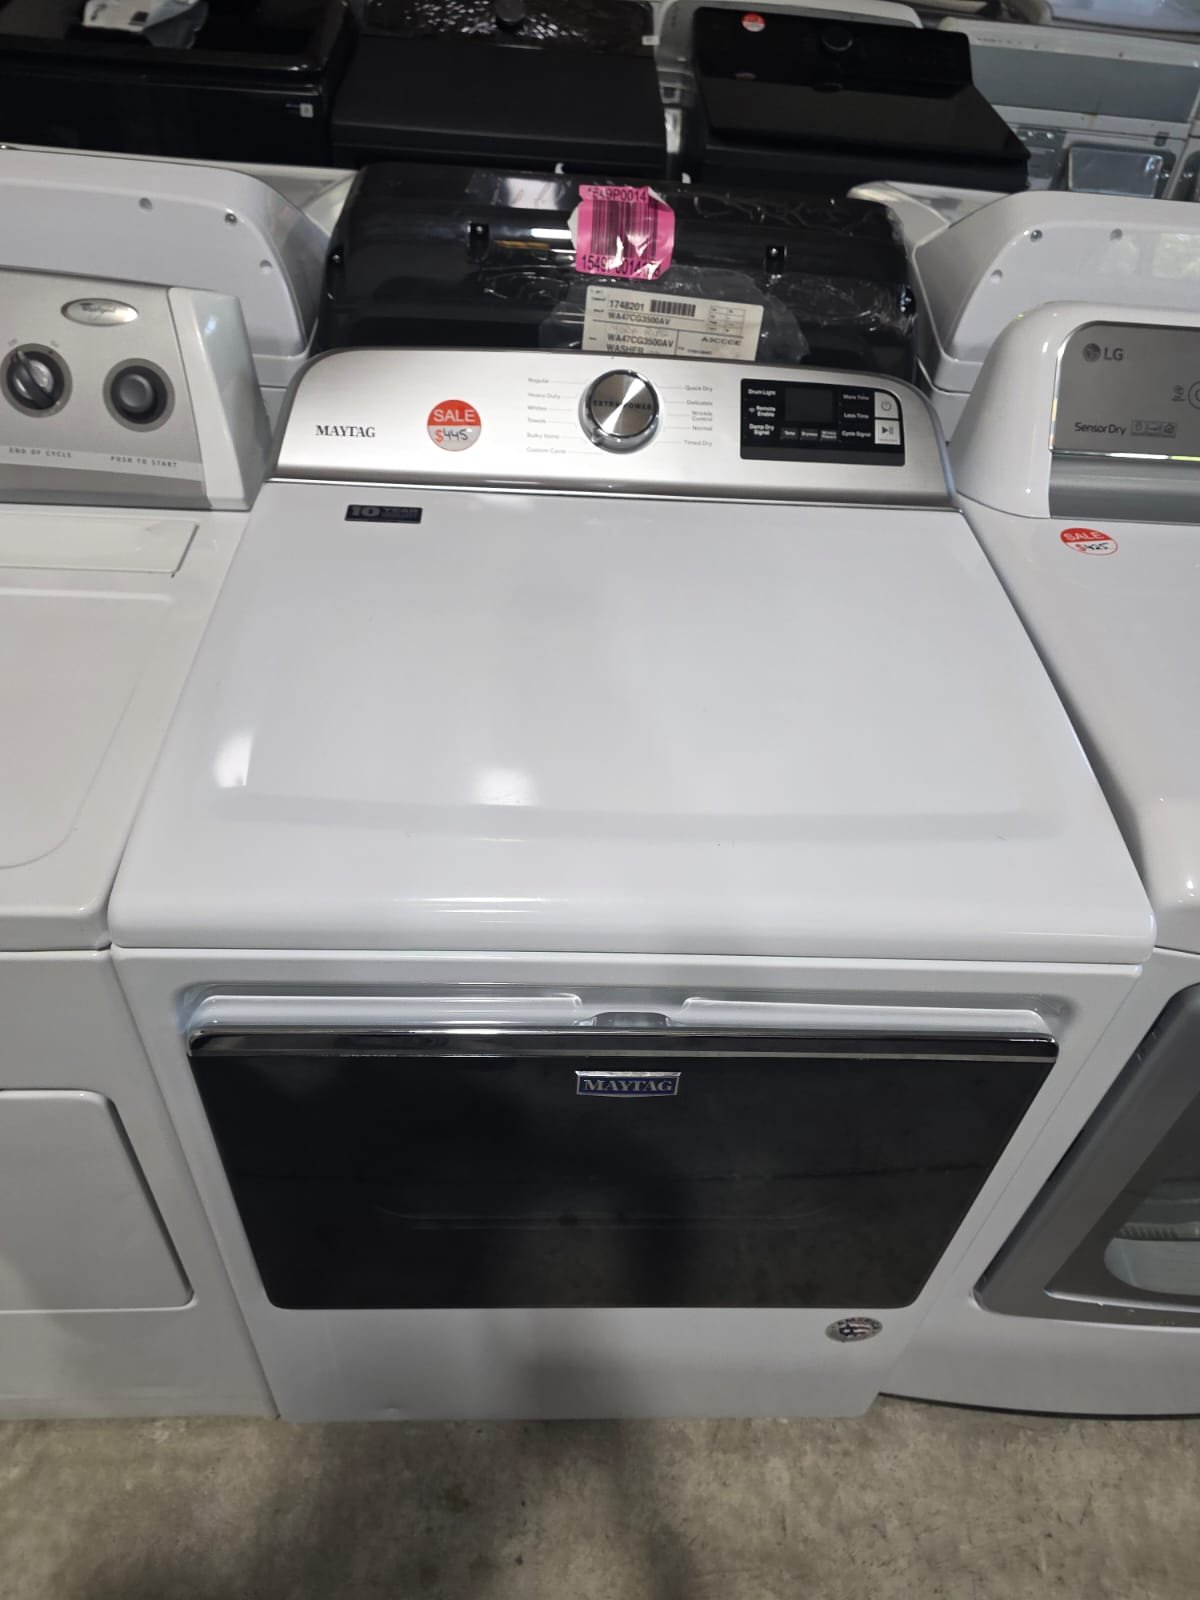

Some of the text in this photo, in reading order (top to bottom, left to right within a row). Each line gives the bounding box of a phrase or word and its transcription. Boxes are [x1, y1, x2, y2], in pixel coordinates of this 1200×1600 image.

[1104, 347, 1124, 361] LG
[703, 385, 713, 393] Dry
[433, 408, 476, 423] SALE
[315, 424, 376, 438] MAYTAG
[749, 423, 764, 431] Damp
[434, 428, 469, 444] $445
[111, 455, 133, 464] PUSH
[152, 459, 178, 468] START
[1063, 531, 1105, 542] SALE
[583, 1079, 672, 1092] MAYTAG
